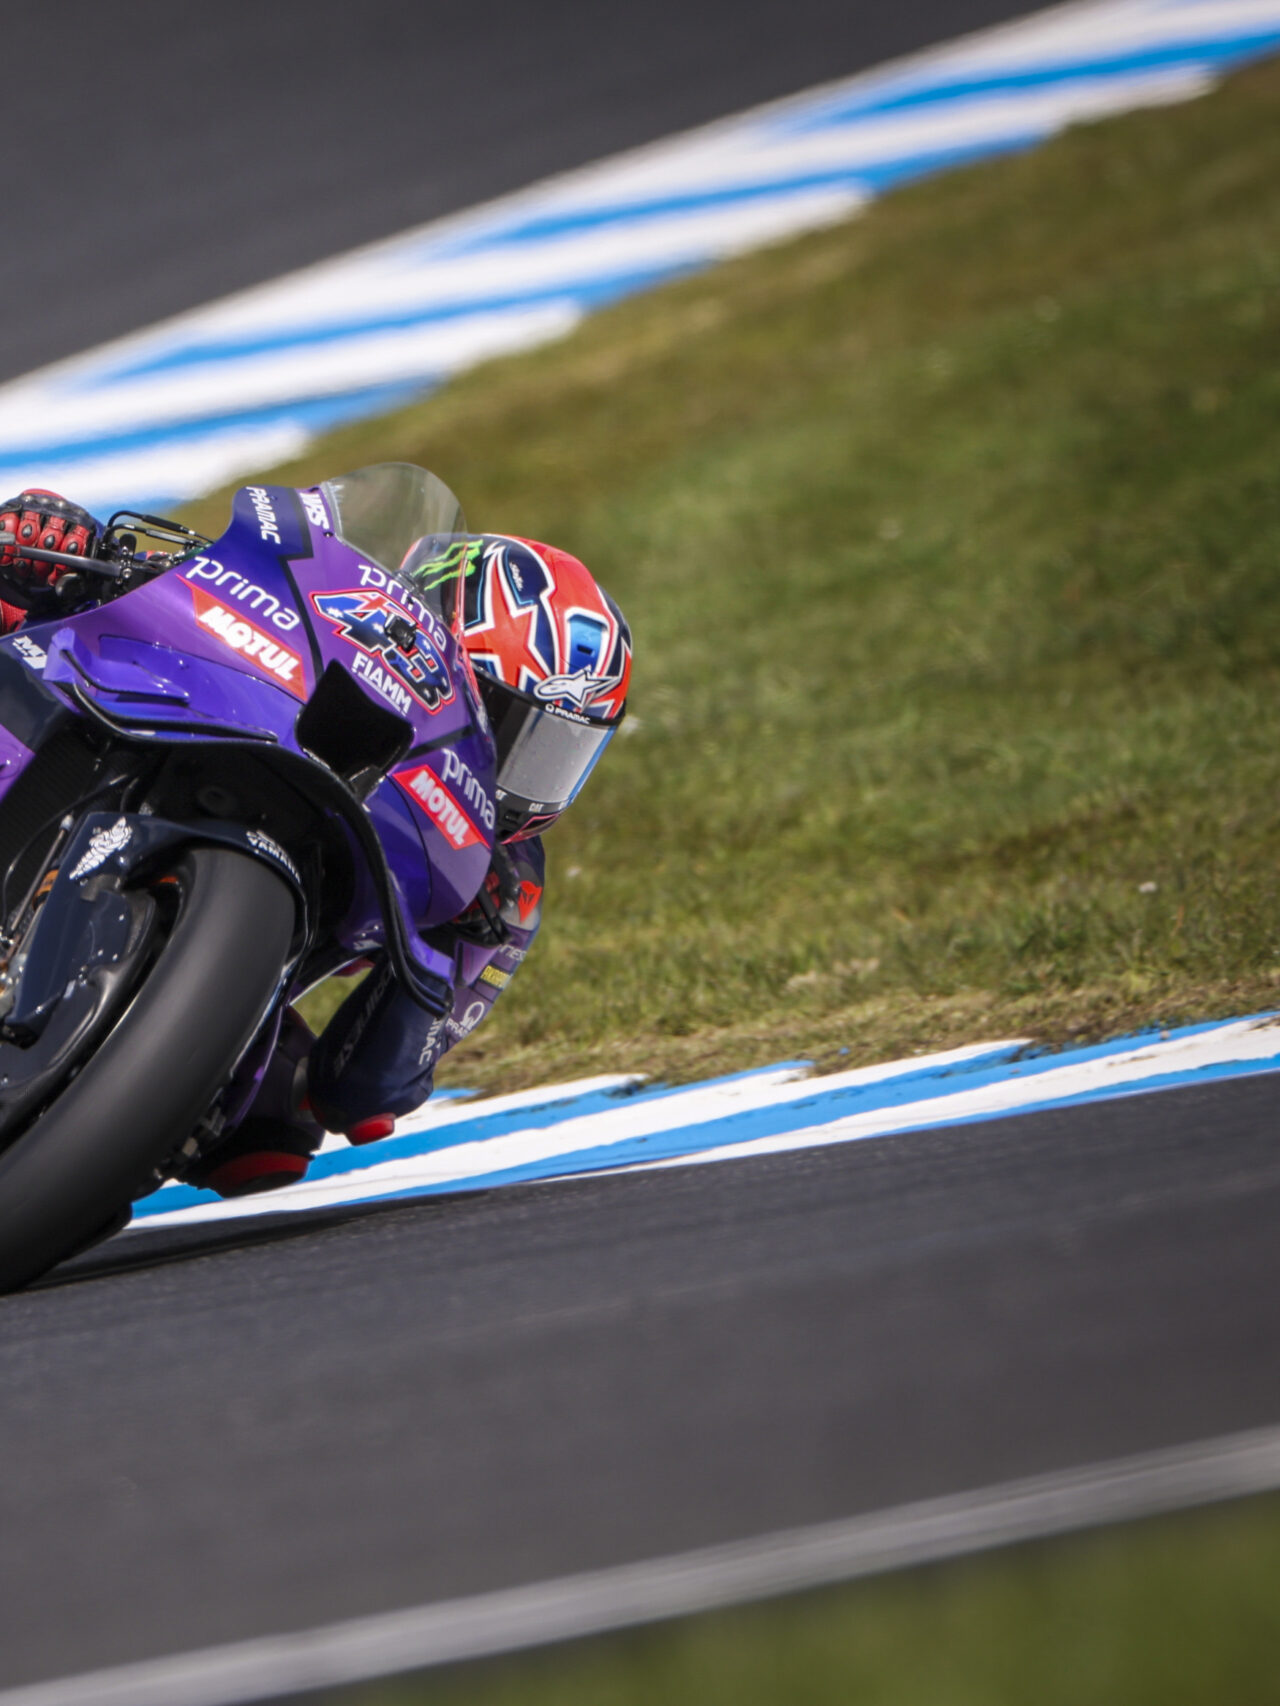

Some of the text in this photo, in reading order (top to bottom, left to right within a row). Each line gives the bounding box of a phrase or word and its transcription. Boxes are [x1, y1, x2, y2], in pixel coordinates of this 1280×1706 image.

[245, 486, 281, 545] PRAMAC
[185, 556, 300, 631] prima
[358, 564, 447, 652] prima
[198, 605, 300, 681] MOTUL
[351, 651, 413, 714] FIAMM
[409, 769, 470, 846] MOTUL
[441, 747, 496, 830] prima
